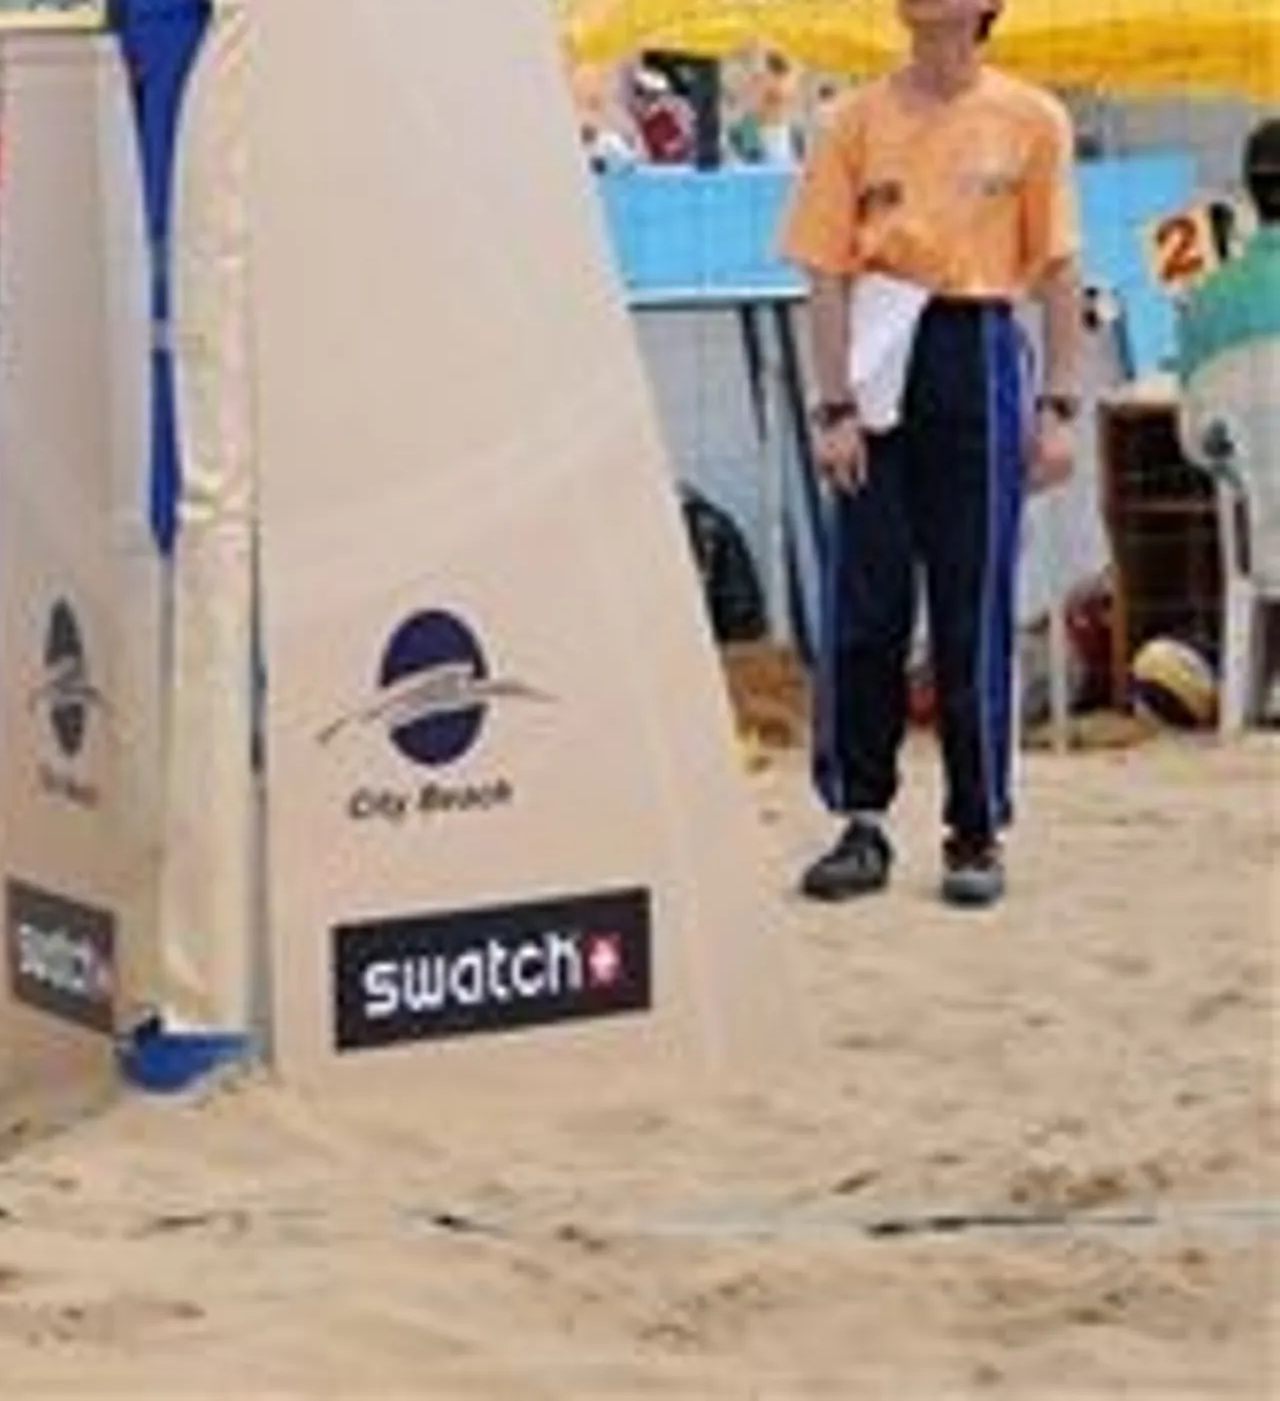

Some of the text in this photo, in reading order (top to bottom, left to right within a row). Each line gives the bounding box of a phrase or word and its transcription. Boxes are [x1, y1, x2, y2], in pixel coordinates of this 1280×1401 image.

[1156, 218, 1204, 285] 2
[348, 777, 514, 826] City Beach
[363, 932, 583, 1018] swatch
